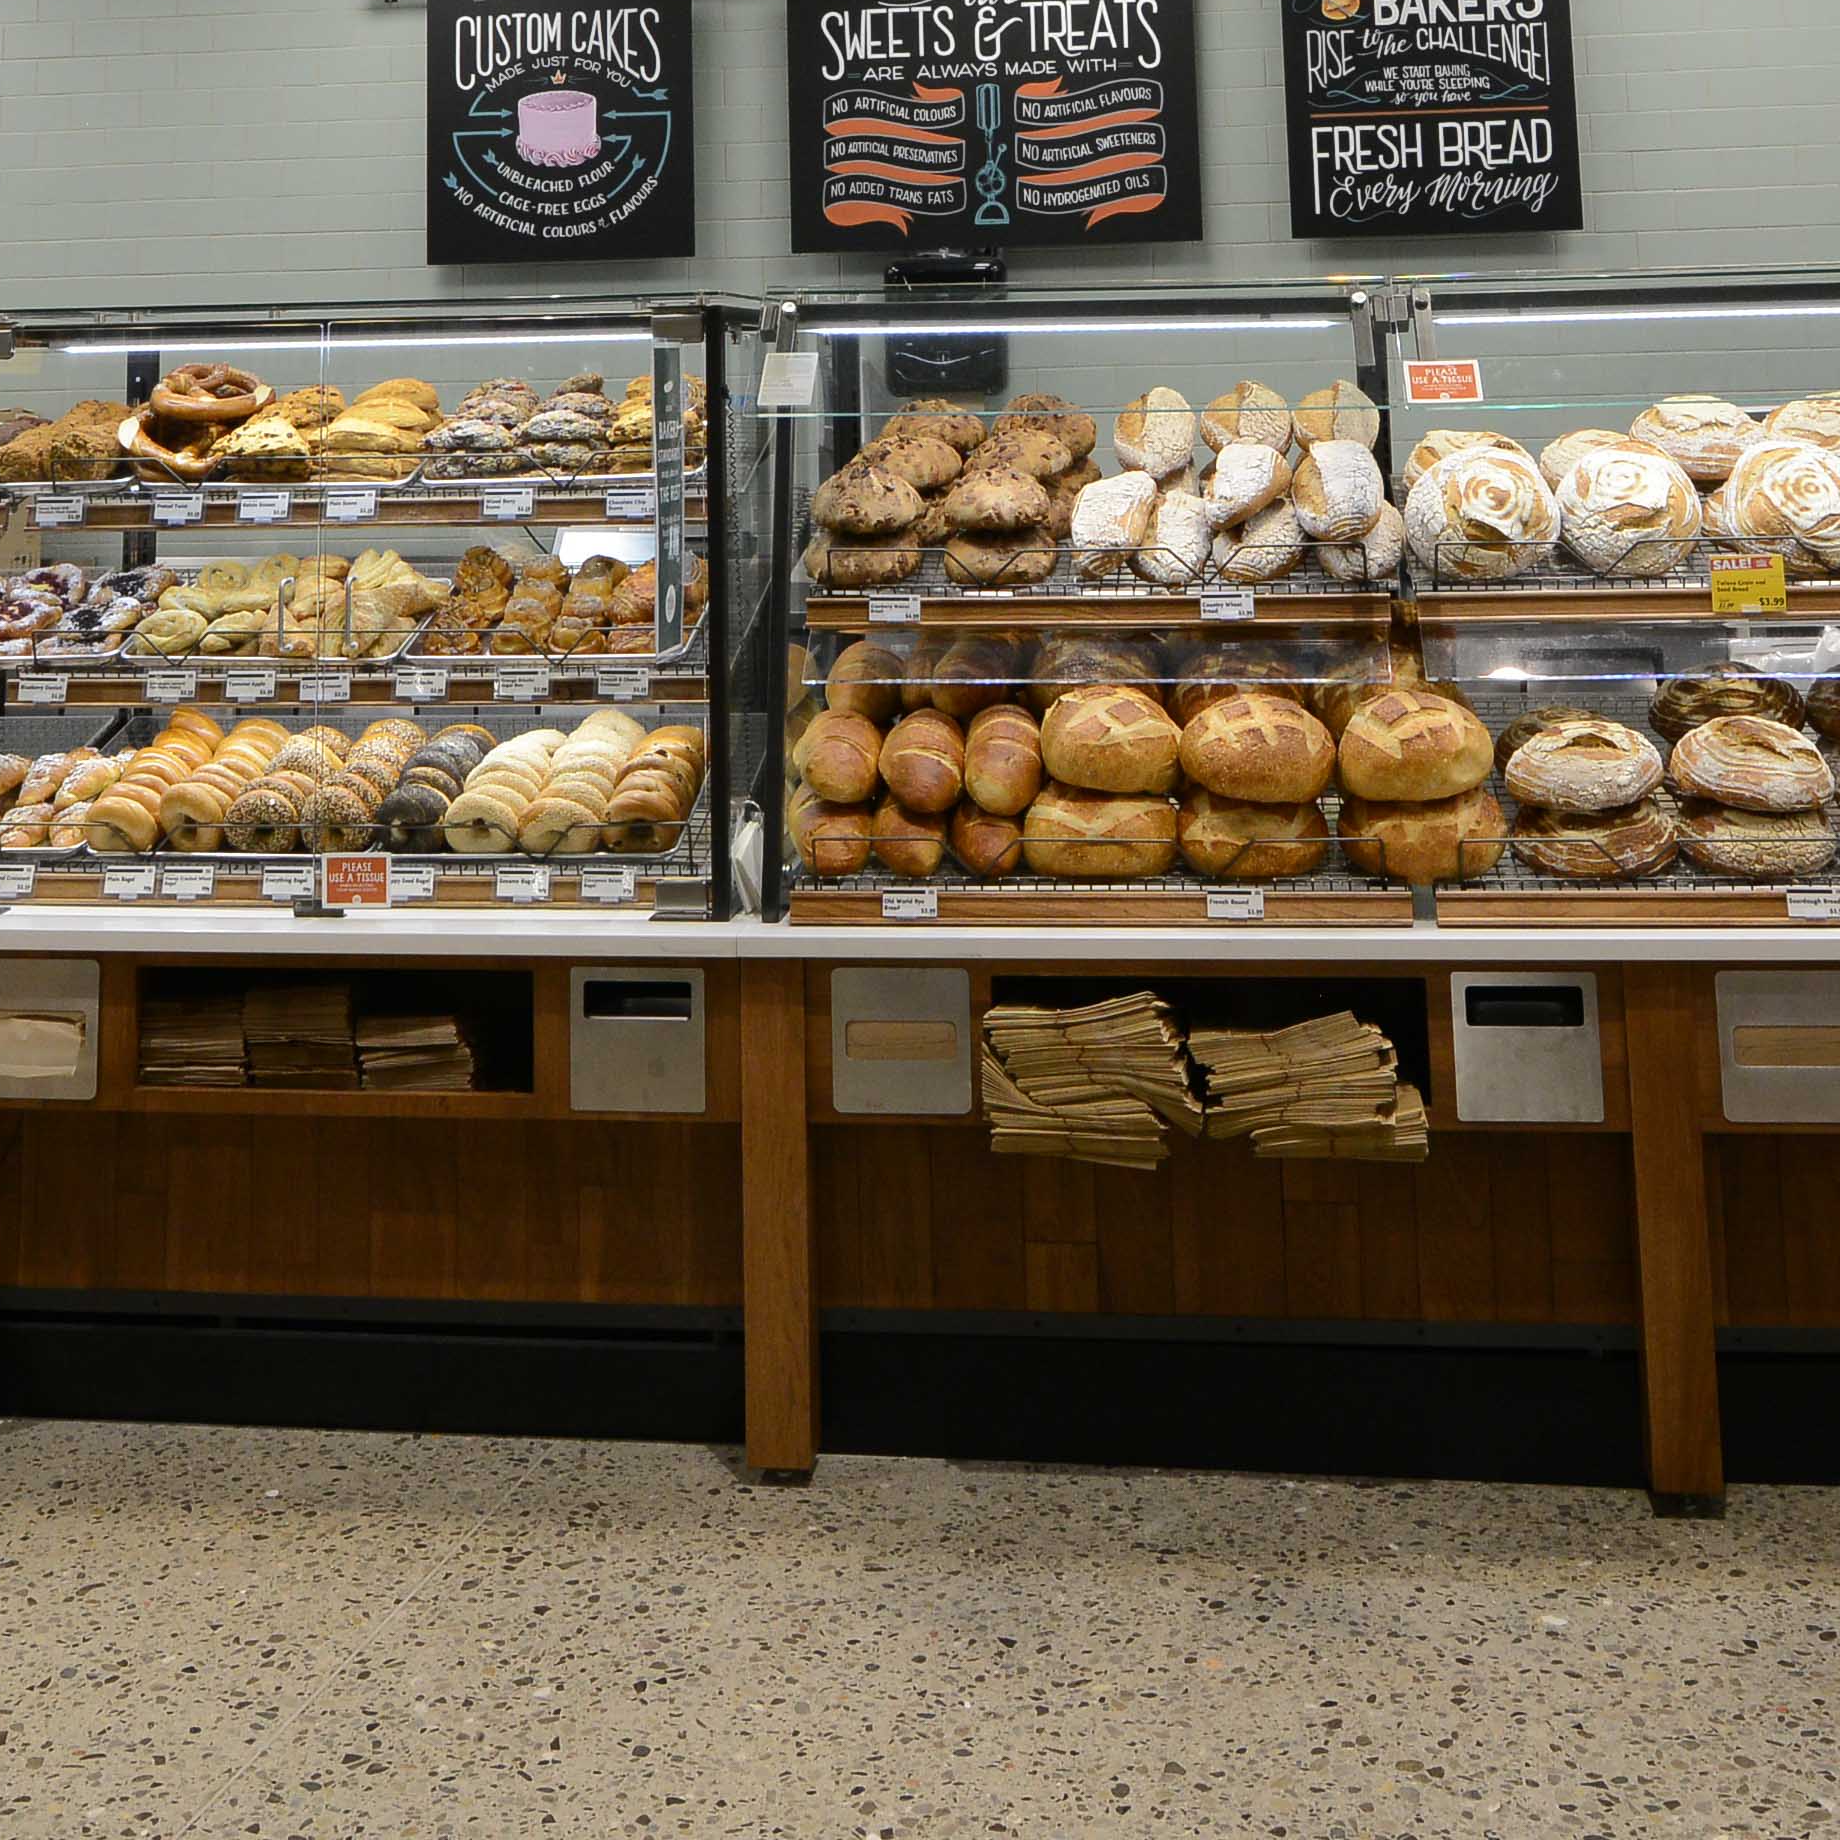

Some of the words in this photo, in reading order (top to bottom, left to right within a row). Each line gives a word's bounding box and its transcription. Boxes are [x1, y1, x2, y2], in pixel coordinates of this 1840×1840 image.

[456, 12, 561, 90] CUSTOM
[571, 8, 661, 82] CAKES
[821, 5, 955, 81] SWEETS
[974, 7, 1023, 61] &
[863, 66, 904, 81] ARE
[917, 63, 998, 79] ALWAYS
[1005, 61, 1057, 76] MADE
[1067, 58, 1117, 73] WITH
[1307, 30, 1355, 93] RISE
[1416, 22, 1550, 86] CHALLENGE!
[1383, 66, 1399, 78] WE
[1402, 66, 1430, 78] START
[1435, 64, 1470, 77] BAKING
[485, 63, 525, 92] MADE
[532, 56, 568, 69] JUST
[574, 58, 601, 73] FOR
[606, 70, 630, 88] YOU
[1365, 80, 1395, 92] WHILE
[1439, 78, 1490, 90] SLEEPING
[832, 101, 848, 116] NO
[855, 97, 911, 120] ARTIFICIAL
[913, 105, 957, 122] COLOURS
[1022, 103, 1041, 119] NO
[1043, 98, 1097, 118] ARTIFICIAL
[1099, 87, 1152, 106] FLAVOURS
[1394, 92, 1408, 104] so
[1411, 92, 1438, 107] you
[1442, 91, 1471, 102] have
[831, 143, 845, 158] NO
[847, 142, 891, 158] ARTIFICIAL
[893, 145, 958, 164] PRESERVATIVES
[1022, 143, 1039, 160] NO
[1042, 142, 1092, 162] ARTIFICIAL
[1097, 133, 1156, 151] SWEETENERS
[497, 162, 573, 193] UNBLEACHED
[578, 160, 615, 187] FLOUR
[1312, 122, 1422, 214] FRESH
[1438, 118, 1553, 170] BREAD
[498, 191, 568, 216] CAGE-FREE
[574, 193, 607, 213] EGGS
[830, 183, 845, 197] NO
[849, 181, 884, 196] ADDED
[889, 185, 923, 204] TRANS
[928, 189, 954, 204] FATS
[1023, 189, 1041, 205] NO
[1043, 180, 1120, 206] HYDROGENATED
[1125, 174, 1150, 190] OILS
[1330, 173, 1421, 217] Every
[1425, 171, 1558, 212] Morning
[454, 186, 472, 206] NO
[474, 202, 536, 236] ARTIFICIAL
[543, 222, 596, 238] COLOURS
[609, 176, 658, 225] FLAVOURS
[1712, 558, 1752, 570] SALE!
[329, 873, 345, 882] USE
[347, 873, 352, 882] A
[357, 874, 384, 883] TISSUE
[342, 863, 372, 872] PLEASE
